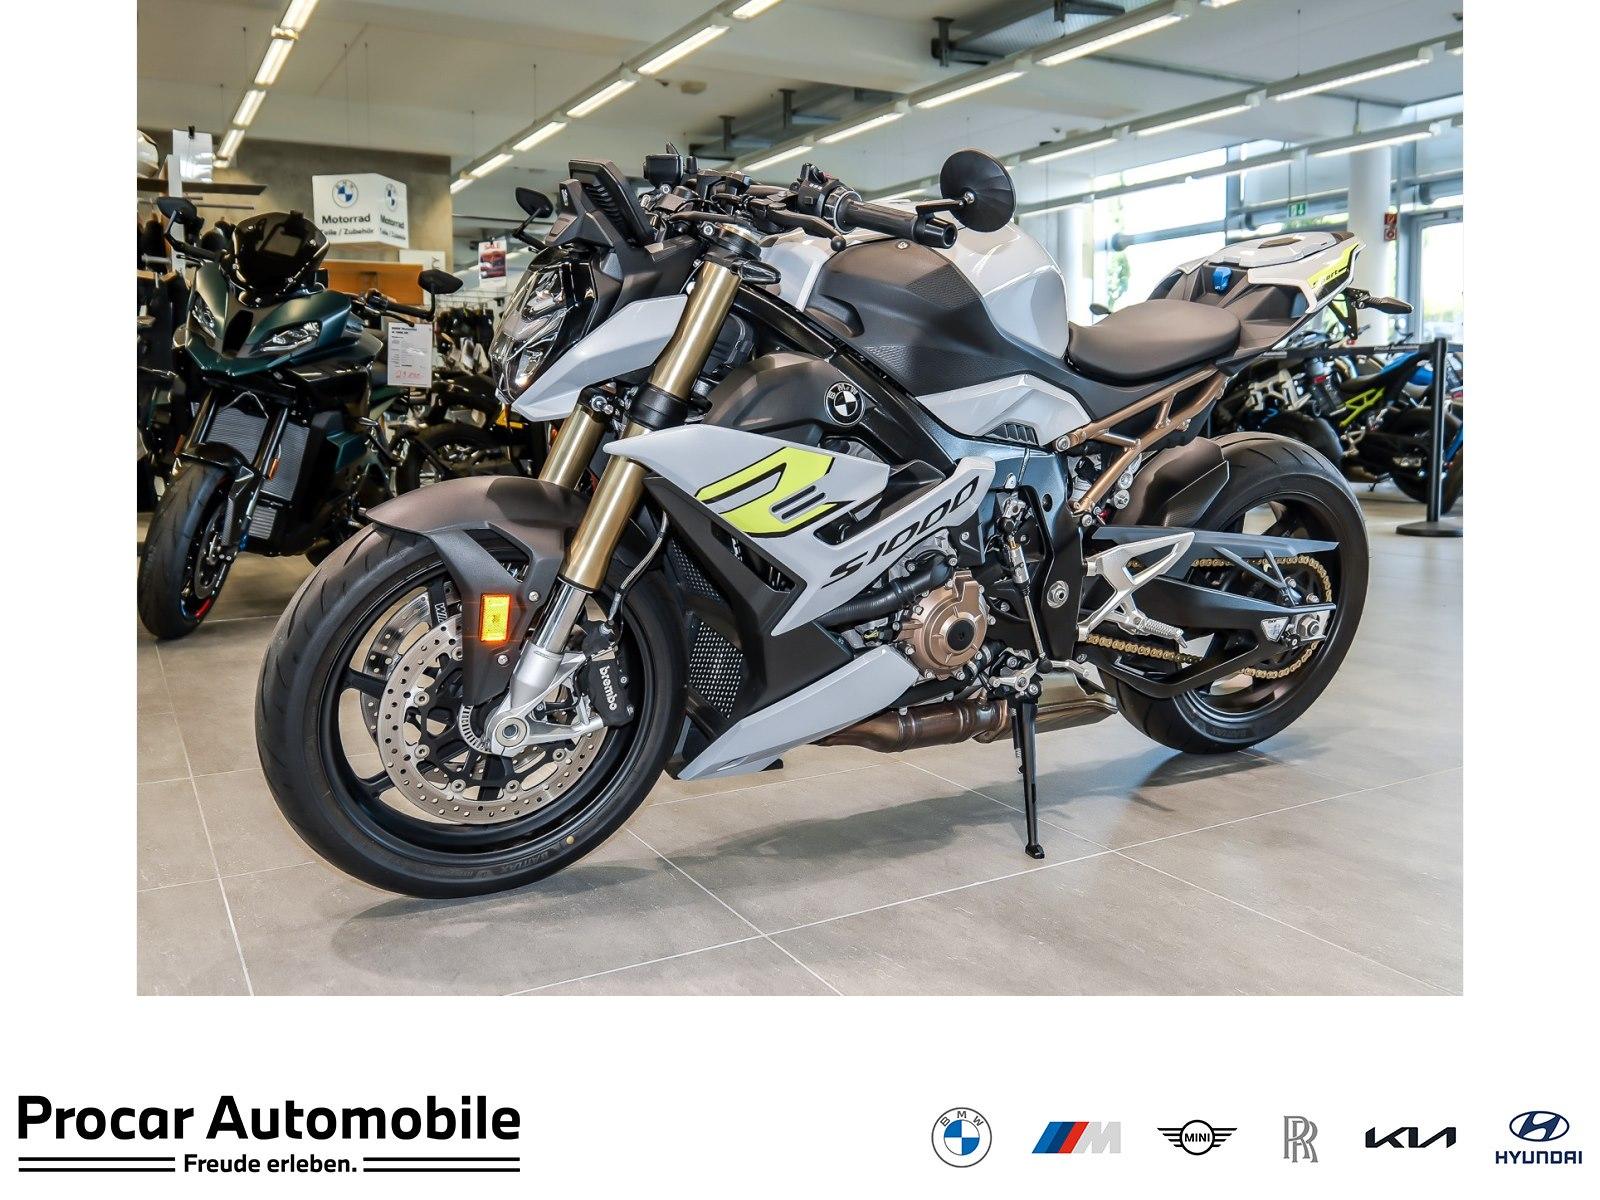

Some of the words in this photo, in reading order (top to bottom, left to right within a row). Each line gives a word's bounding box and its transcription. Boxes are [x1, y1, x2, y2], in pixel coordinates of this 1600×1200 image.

[321, 213, 371, 225] Motorrad
[820, 475, 981, 589] S1000
[599, 665, 618, 711] brembo
